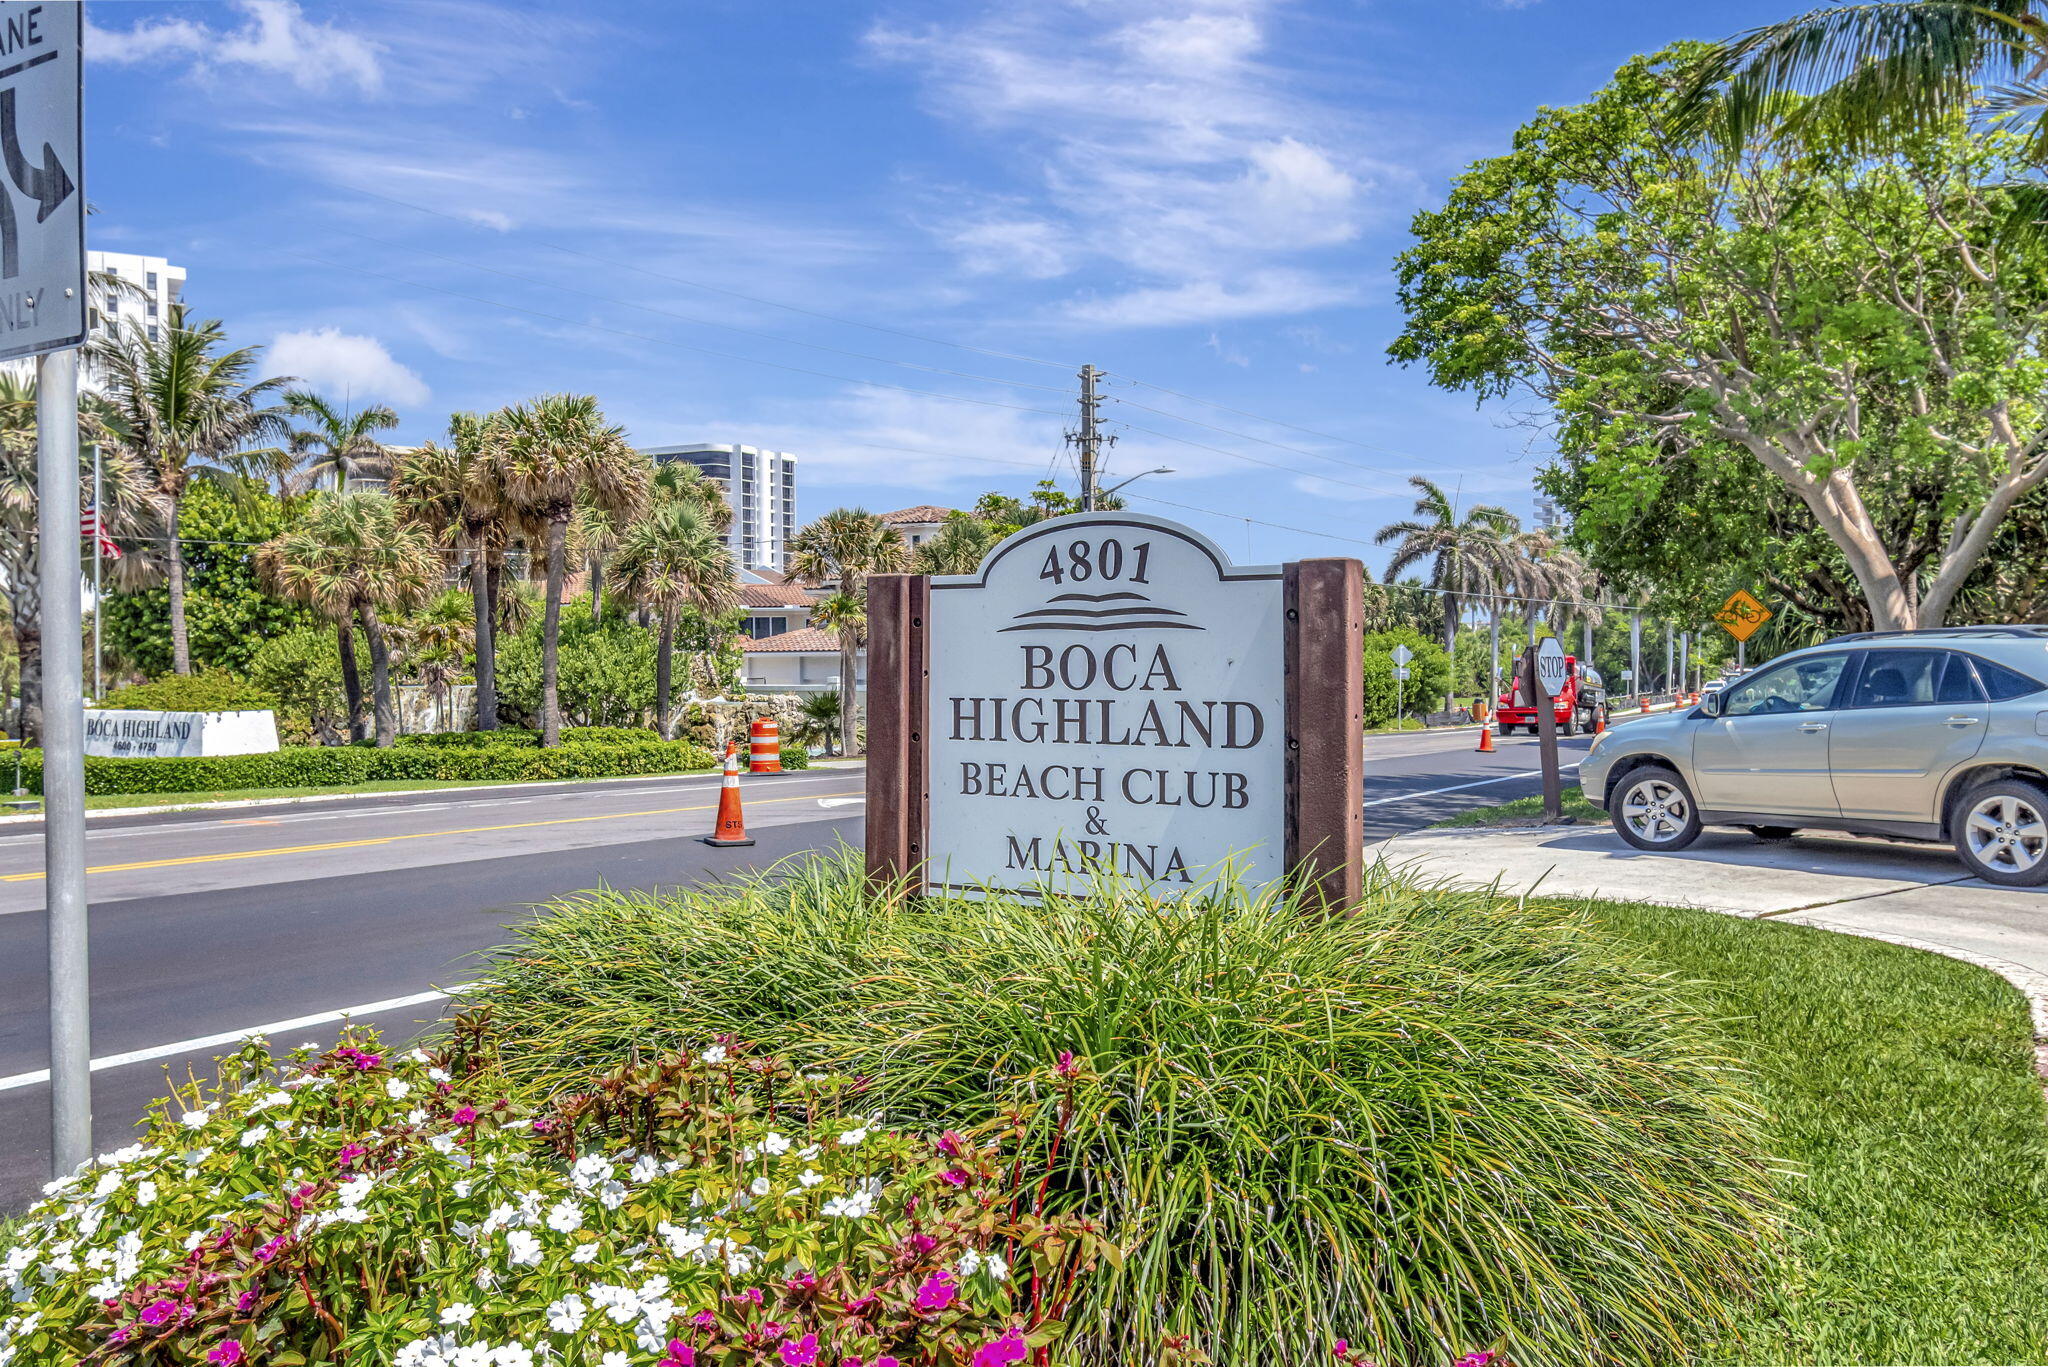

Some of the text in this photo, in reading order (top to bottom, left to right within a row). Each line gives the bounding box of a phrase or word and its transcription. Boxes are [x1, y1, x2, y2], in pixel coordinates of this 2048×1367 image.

[1039, 538, 1151, 585] 4801
[1020, 643, 1182, 692] BOCA
[1540, 655, 1564, 678] STOP
[87, 718, 191, 740] BOCA HIGHLAND
[948, 697, 1264, 750] HIGHLAND
[960, 762, 1249, 810] BEACH CLUB
[1085, 805, 1110, 836] &
[1005, 835, 1194, 883] MARINA
